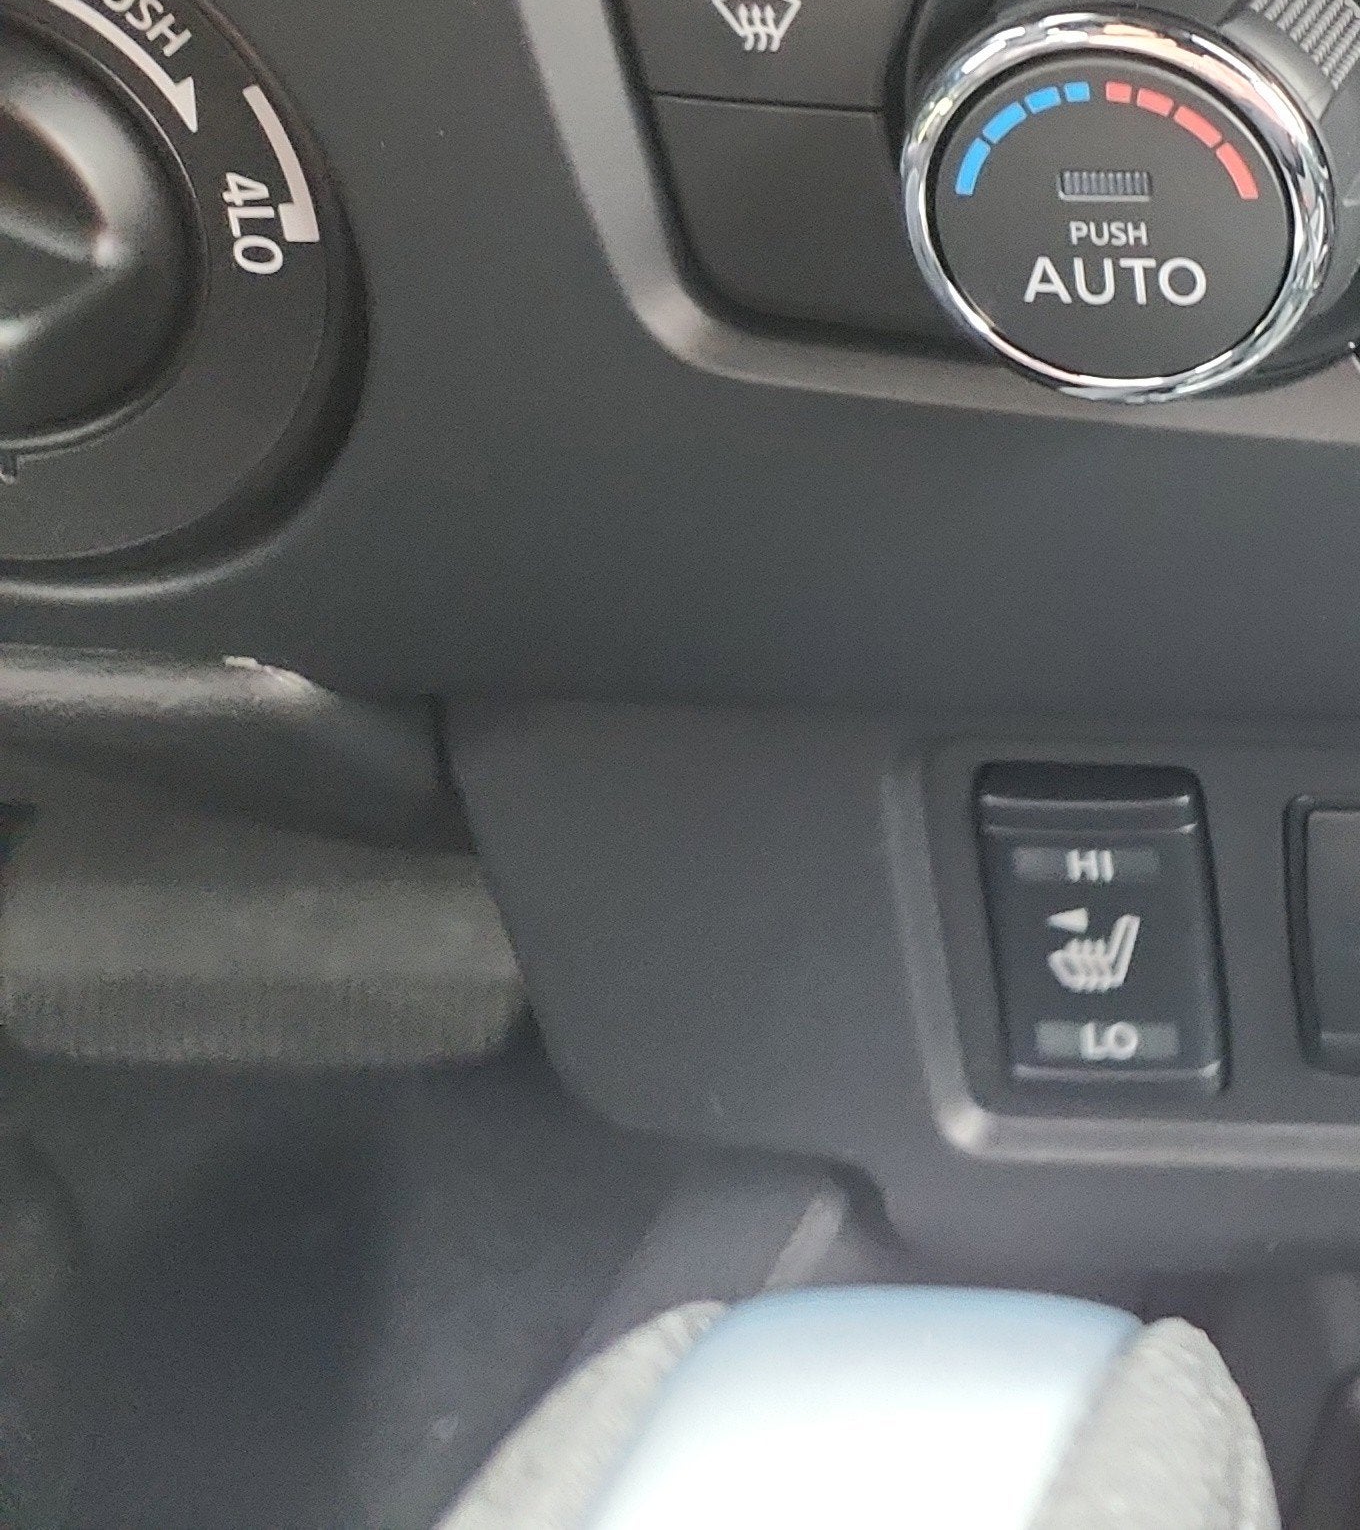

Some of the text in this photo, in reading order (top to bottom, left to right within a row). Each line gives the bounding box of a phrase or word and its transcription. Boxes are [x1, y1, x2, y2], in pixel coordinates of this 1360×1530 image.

[221, 171, 285, 276] 4LO
[1069, 221, 1149, 247] PUSH
[1023, 256, 1208, 307] AUTO
[1066, 848, 1115, 883] HI
[1078, 1020, 1141, 1061] LO
